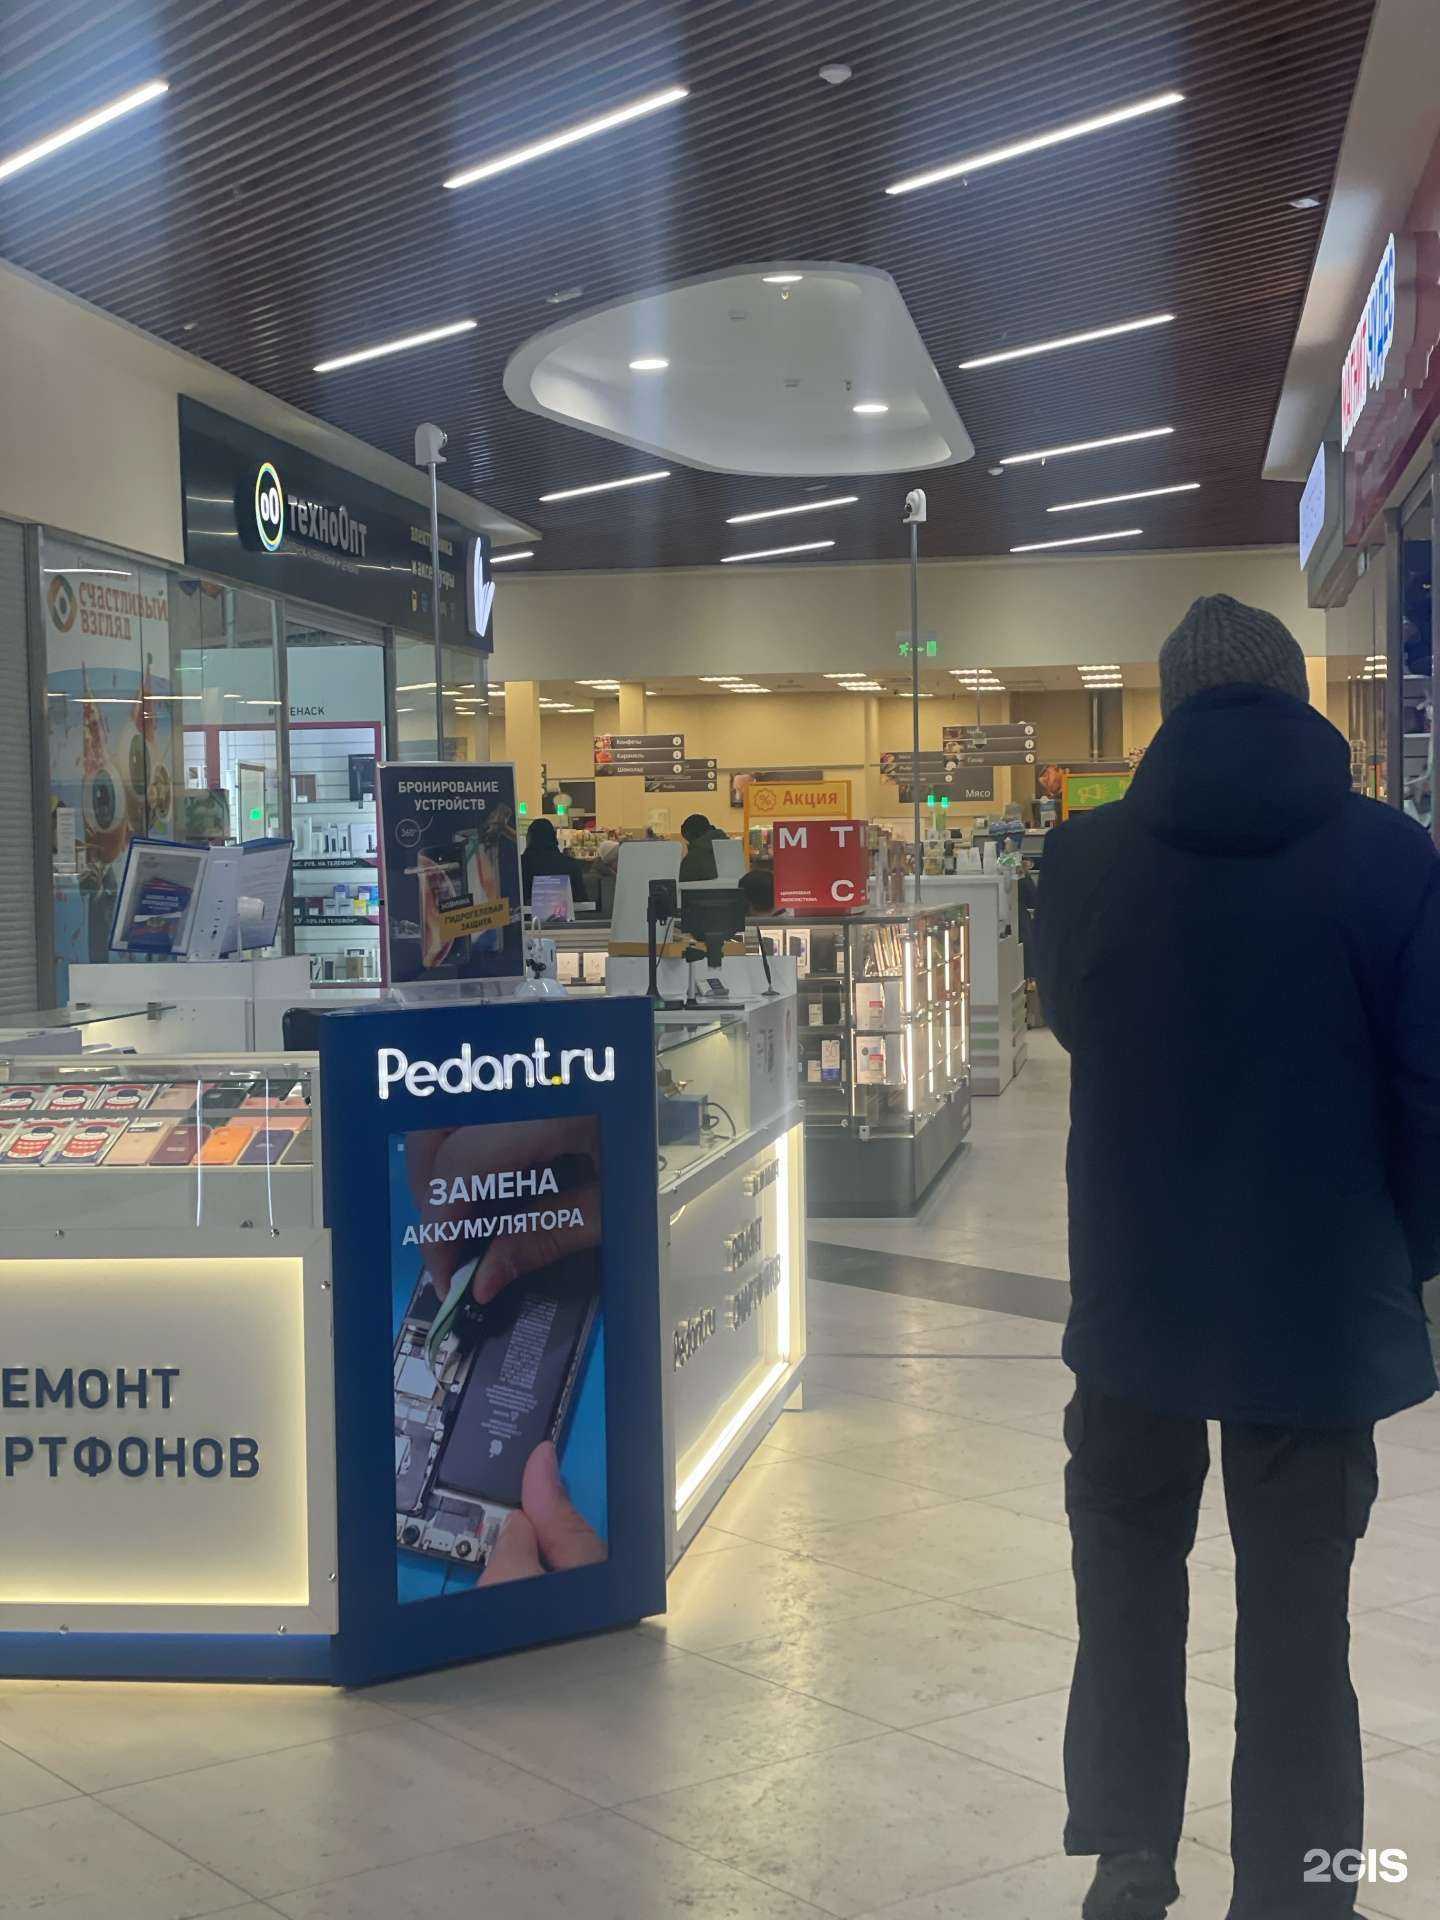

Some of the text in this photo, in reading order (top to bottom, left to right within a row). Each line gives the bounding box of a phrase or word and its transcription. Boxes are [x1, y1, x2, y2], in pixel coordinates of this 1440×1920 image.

[80, 609, 132, 641] ВЗГЛЯД
[398, 780, 500, 793] БРОНИРОВАНИЕ
[414, 796, 486, 811] УСТРОЙСТВ
[782, 790, 838, 808] Акция
[965, 789, 991, 799] Мясо
[378, 1037, 615, 1100] Pedant.ru
[428, 1167, 560, 1206] ЗАМЕНА
[402, 1207, 585, 1246] АККУМУЛЯТОРА
[2, 1368, 180, 1409] ЕМОНТ
[5, 1437, 260, 1478] РТФОНОВ
